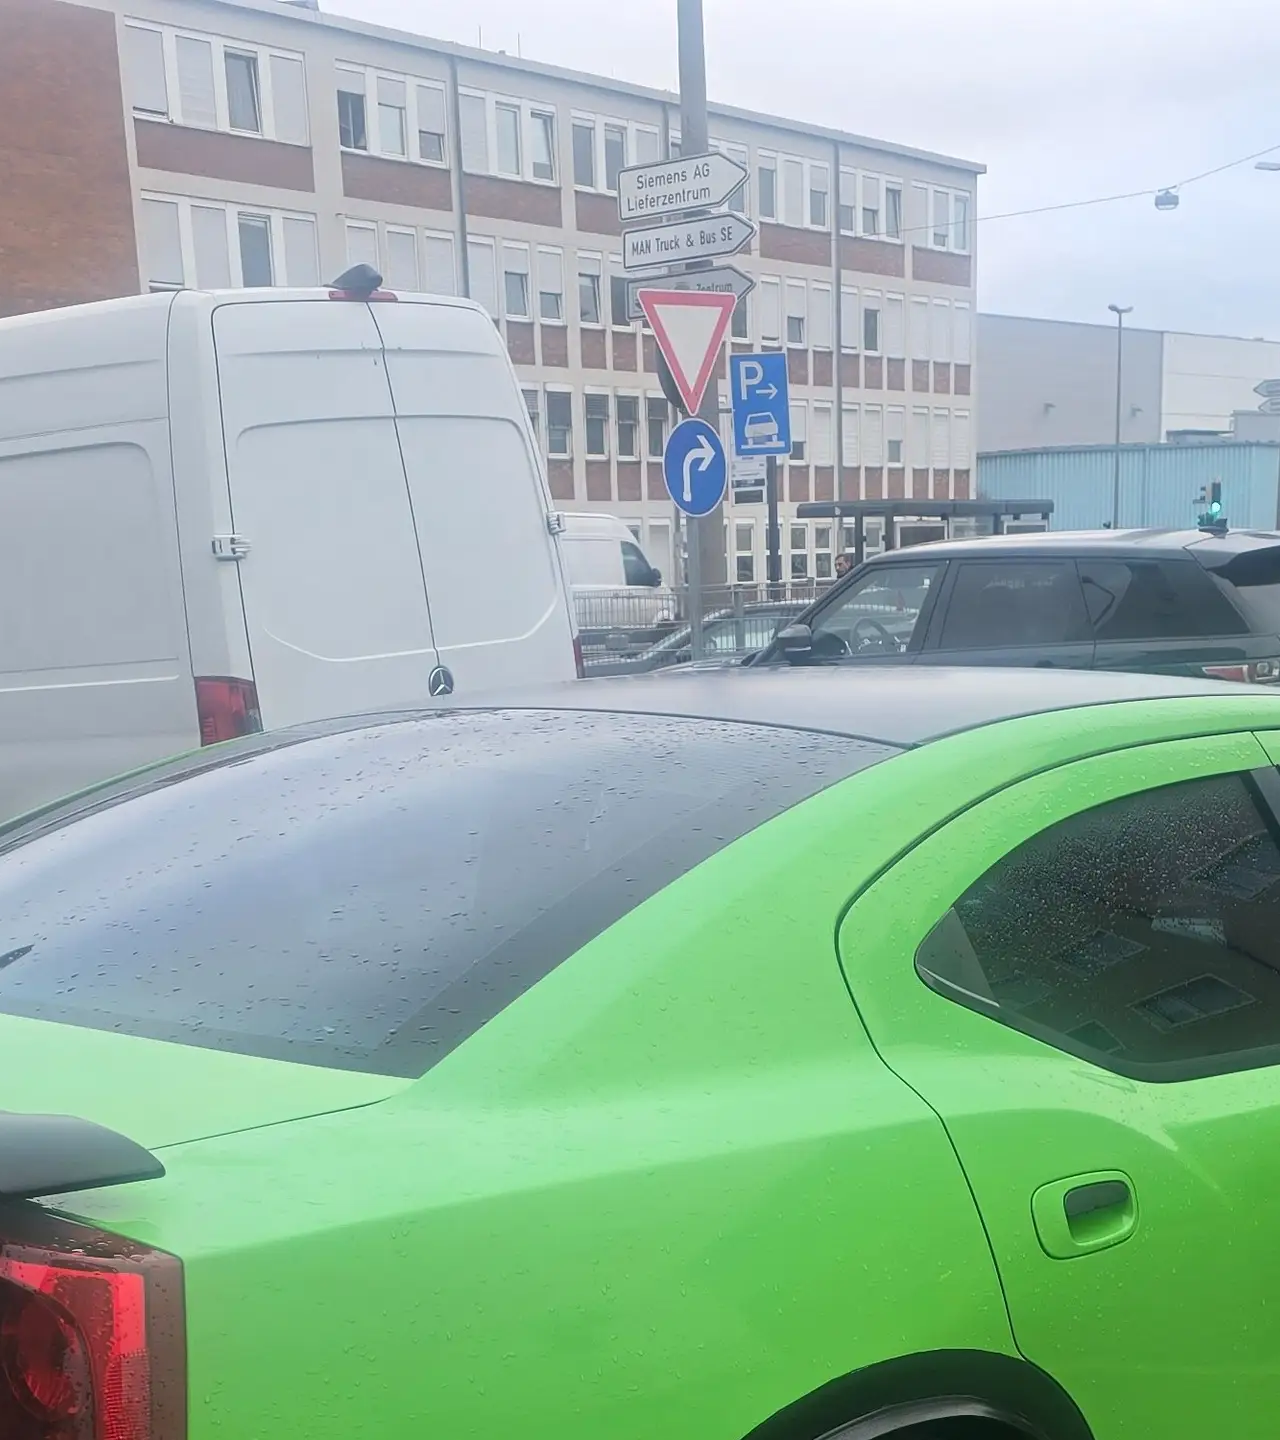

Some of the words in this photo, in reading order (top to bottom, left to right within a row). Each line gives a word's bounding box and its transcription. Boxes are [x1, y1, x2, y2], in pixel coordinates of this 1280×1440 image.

[636, 169, 688, 190] Siemens
[693, 162, 711, 180] AG
[627, 186, 712, 212] Lieferzentrum
[631, 239, 652, 256] MAN
[655, 234, 681, 253] Truck
[686, 234, 694, 247] &
[699, 229, 717, 246] Bus
[720, 226, 733, 242] SE
[740, 361, 764, 400] P
